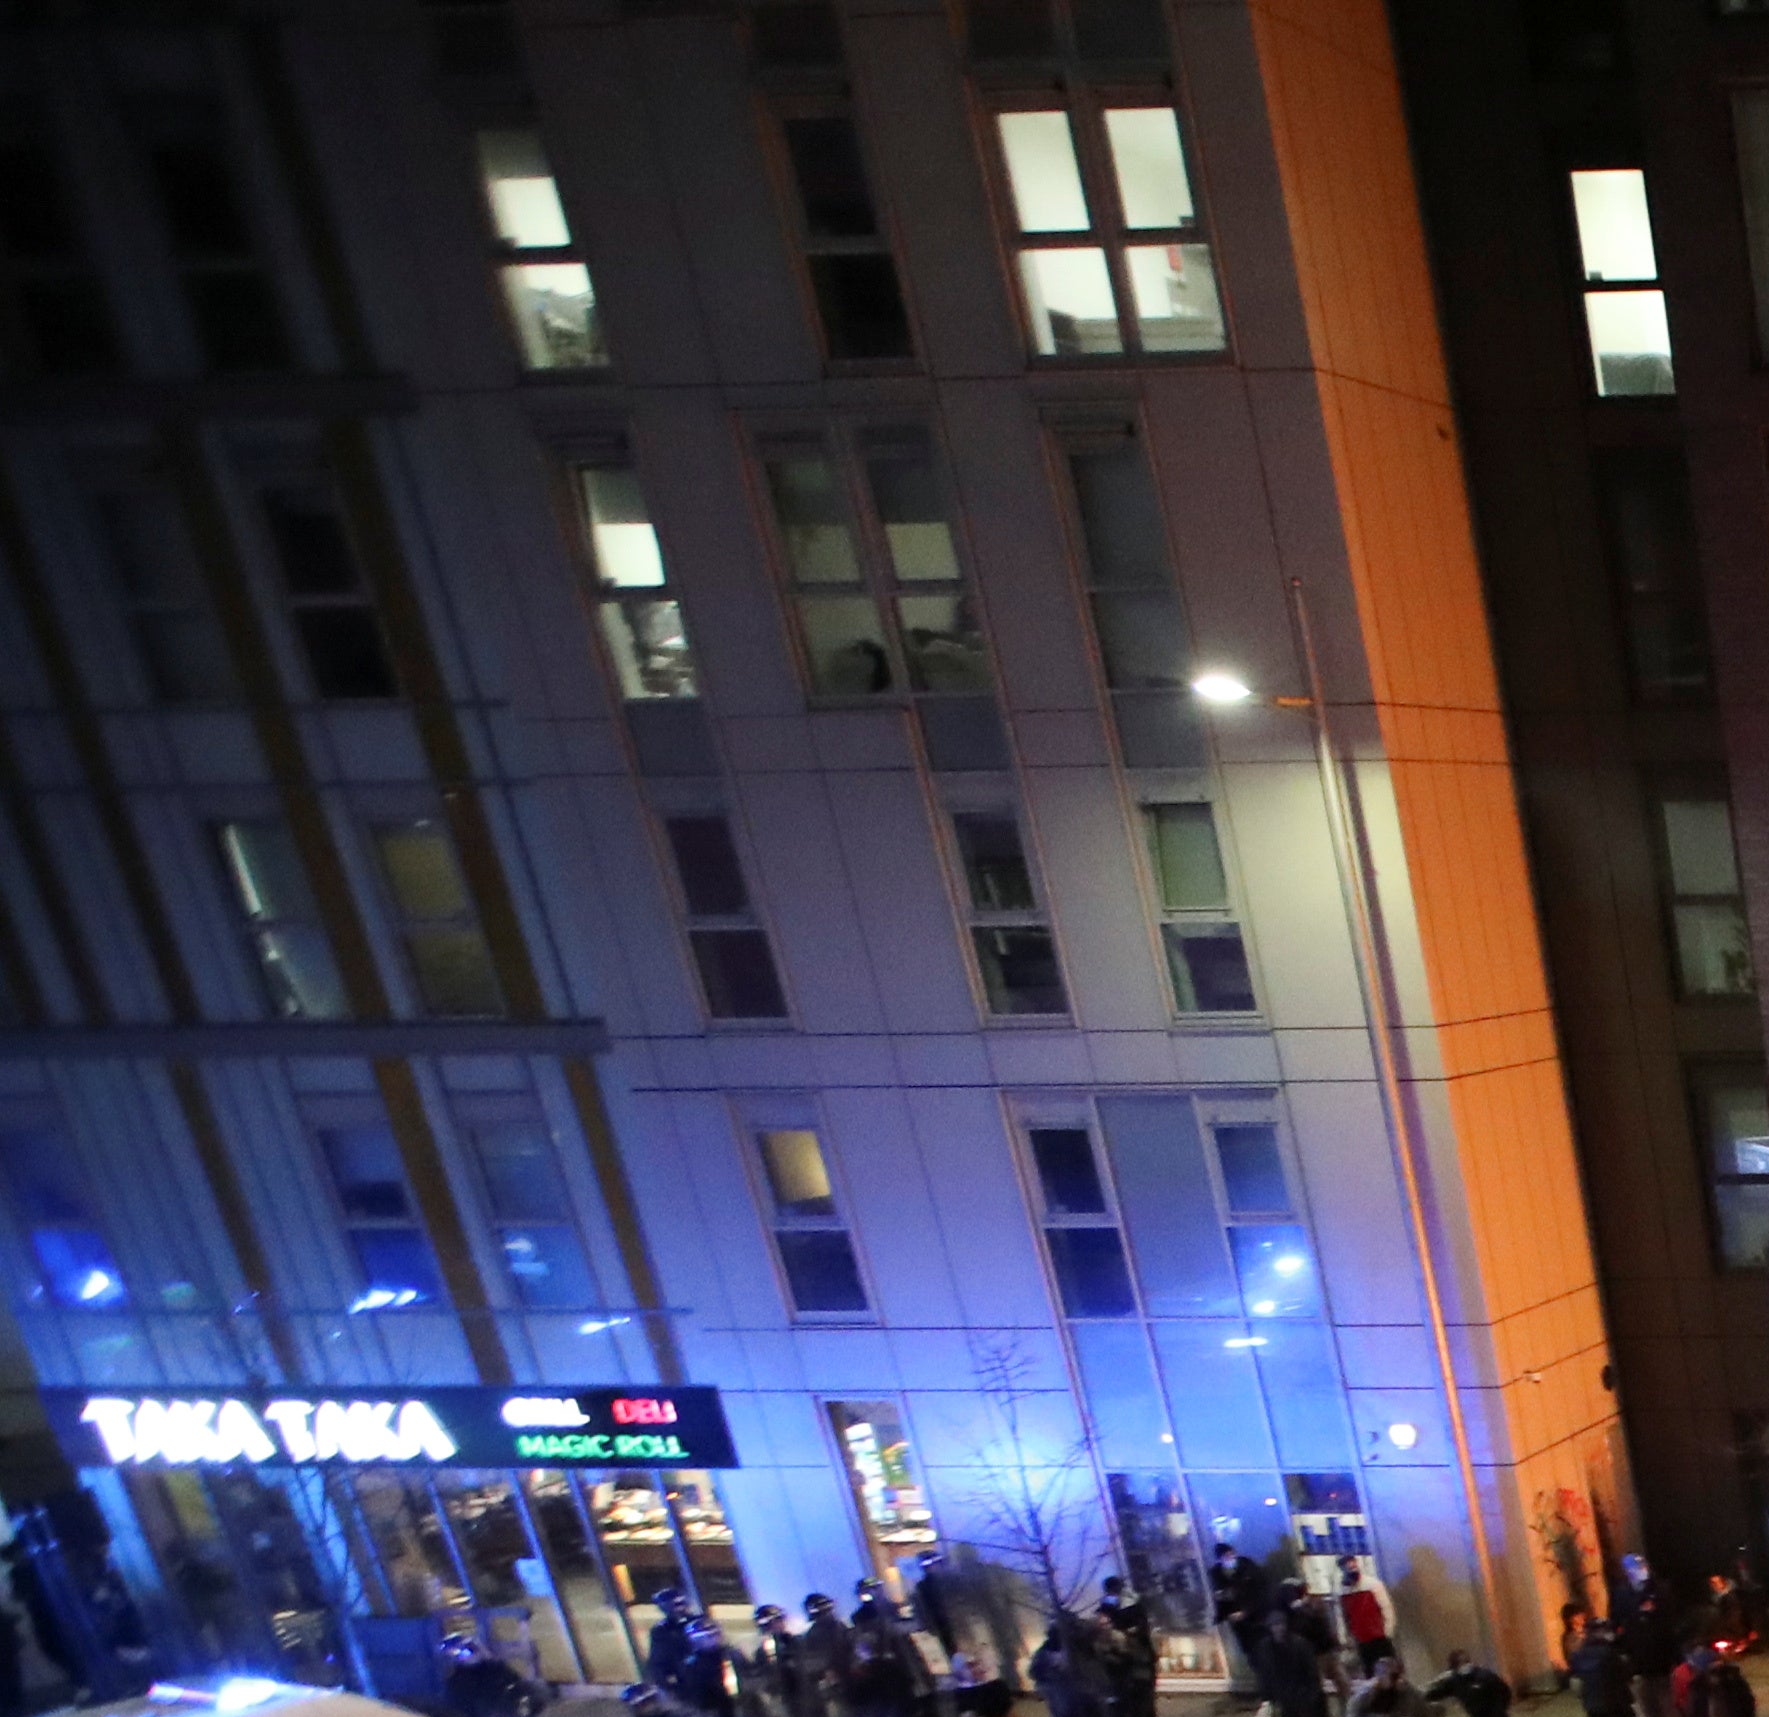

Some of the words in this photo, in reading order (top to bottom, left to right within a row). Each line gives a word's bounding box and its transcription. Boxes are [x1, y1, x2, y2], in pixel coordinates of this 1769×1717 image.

[612, 1398, 677, 1424] DELI
[80, 1398, 276, 1463] TAKA
[264, 1398, 456, 1462] TAKA
[516, 1434, 615, 1459] MAGIC
[614, 1434, 690, 1459] ROLL
